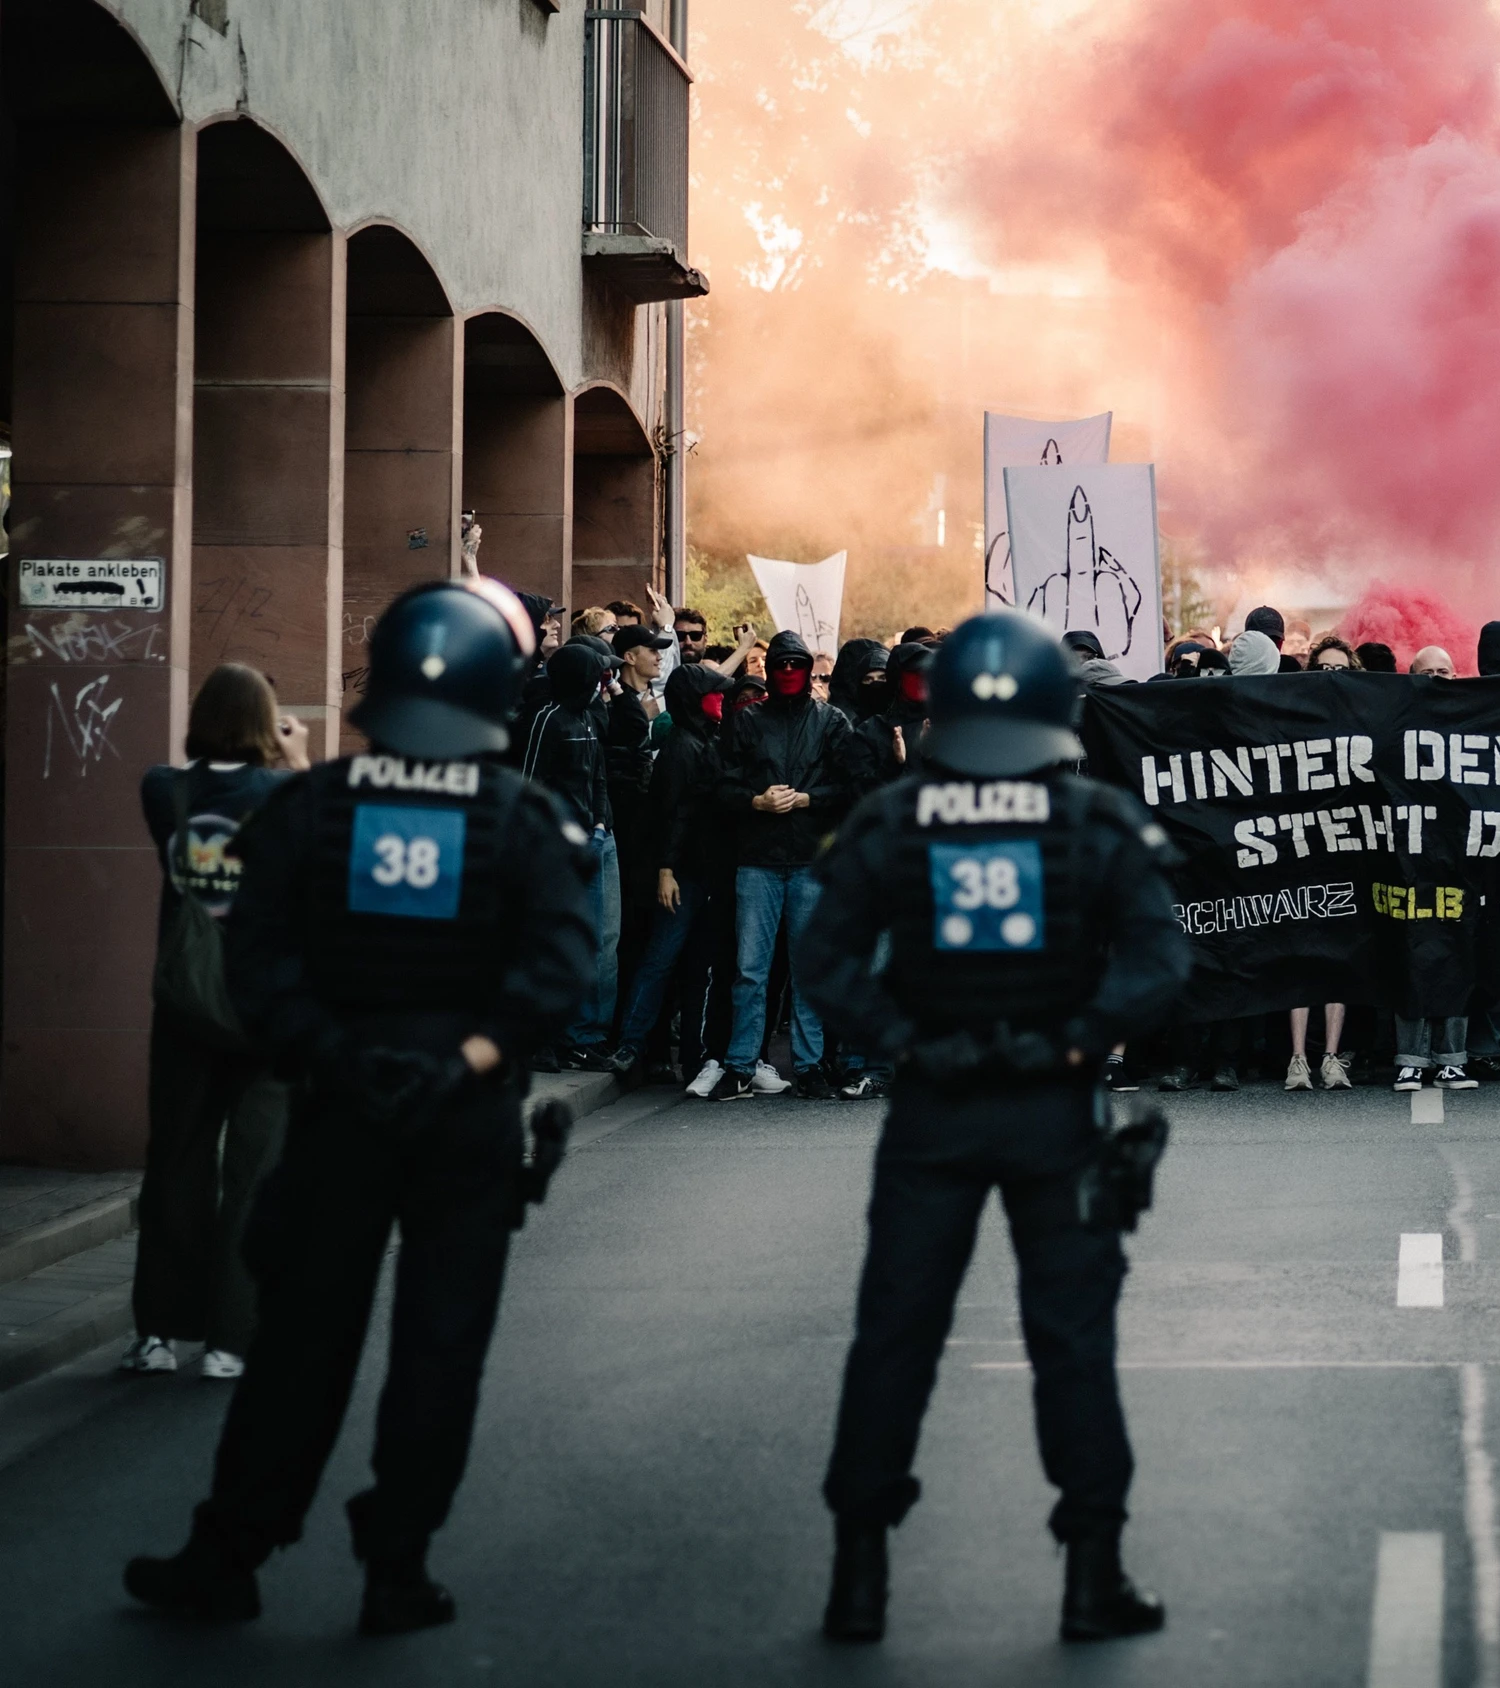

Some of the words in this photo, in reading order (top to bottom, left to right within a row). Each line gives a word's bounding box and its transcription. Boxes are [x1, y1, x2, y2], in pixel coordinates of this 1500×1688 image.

[21, 562, 80, 577] Plakate
[87, 562, 158, 577] ankleben
[347, 755, 480, 797] POLIZEI
[1141, 735, 1376, 806] HINTER
[917, 779, 1050, 827] POLIZEI
[371, 833, 441, 889] 38
[1234, 804, 1437, 868] STEHT
[951, 857, 1021, 911] 38
[1171, 882, 1357, 935] SCHWARZ
[1372, 882, 1466, 920] GELB
